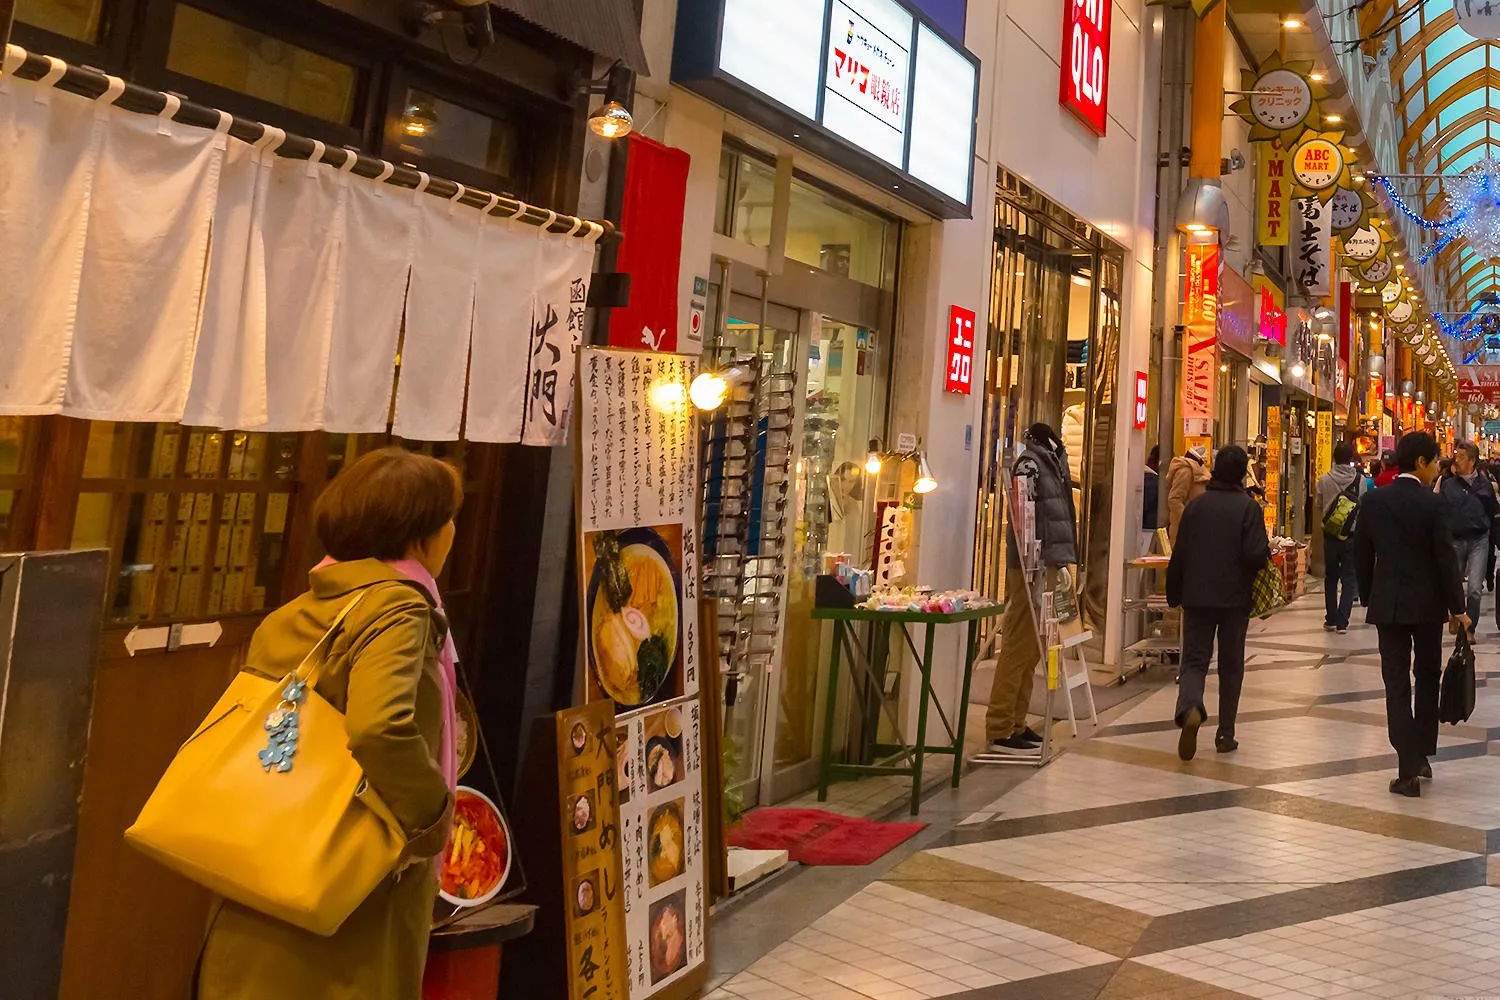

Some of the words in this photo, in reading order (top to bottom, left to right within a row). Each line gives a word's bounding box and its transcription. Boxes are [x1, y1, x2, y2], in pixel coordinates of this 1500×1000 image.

[1071, 21, 1105, 107] QLO
[1257, 96, 1302, 106] クリニック
[1304, 162, 1330, 171] MART
[1305, 149, 1330, 161] ABC
[1298, 195, 1325, 287] 富士そば
[1202, 292, 1217, 322] 160
[953, 316, 972, 349] ユニ
[529, 304, 561, 427] 大門
[950, 351, 971, 386] クロ
